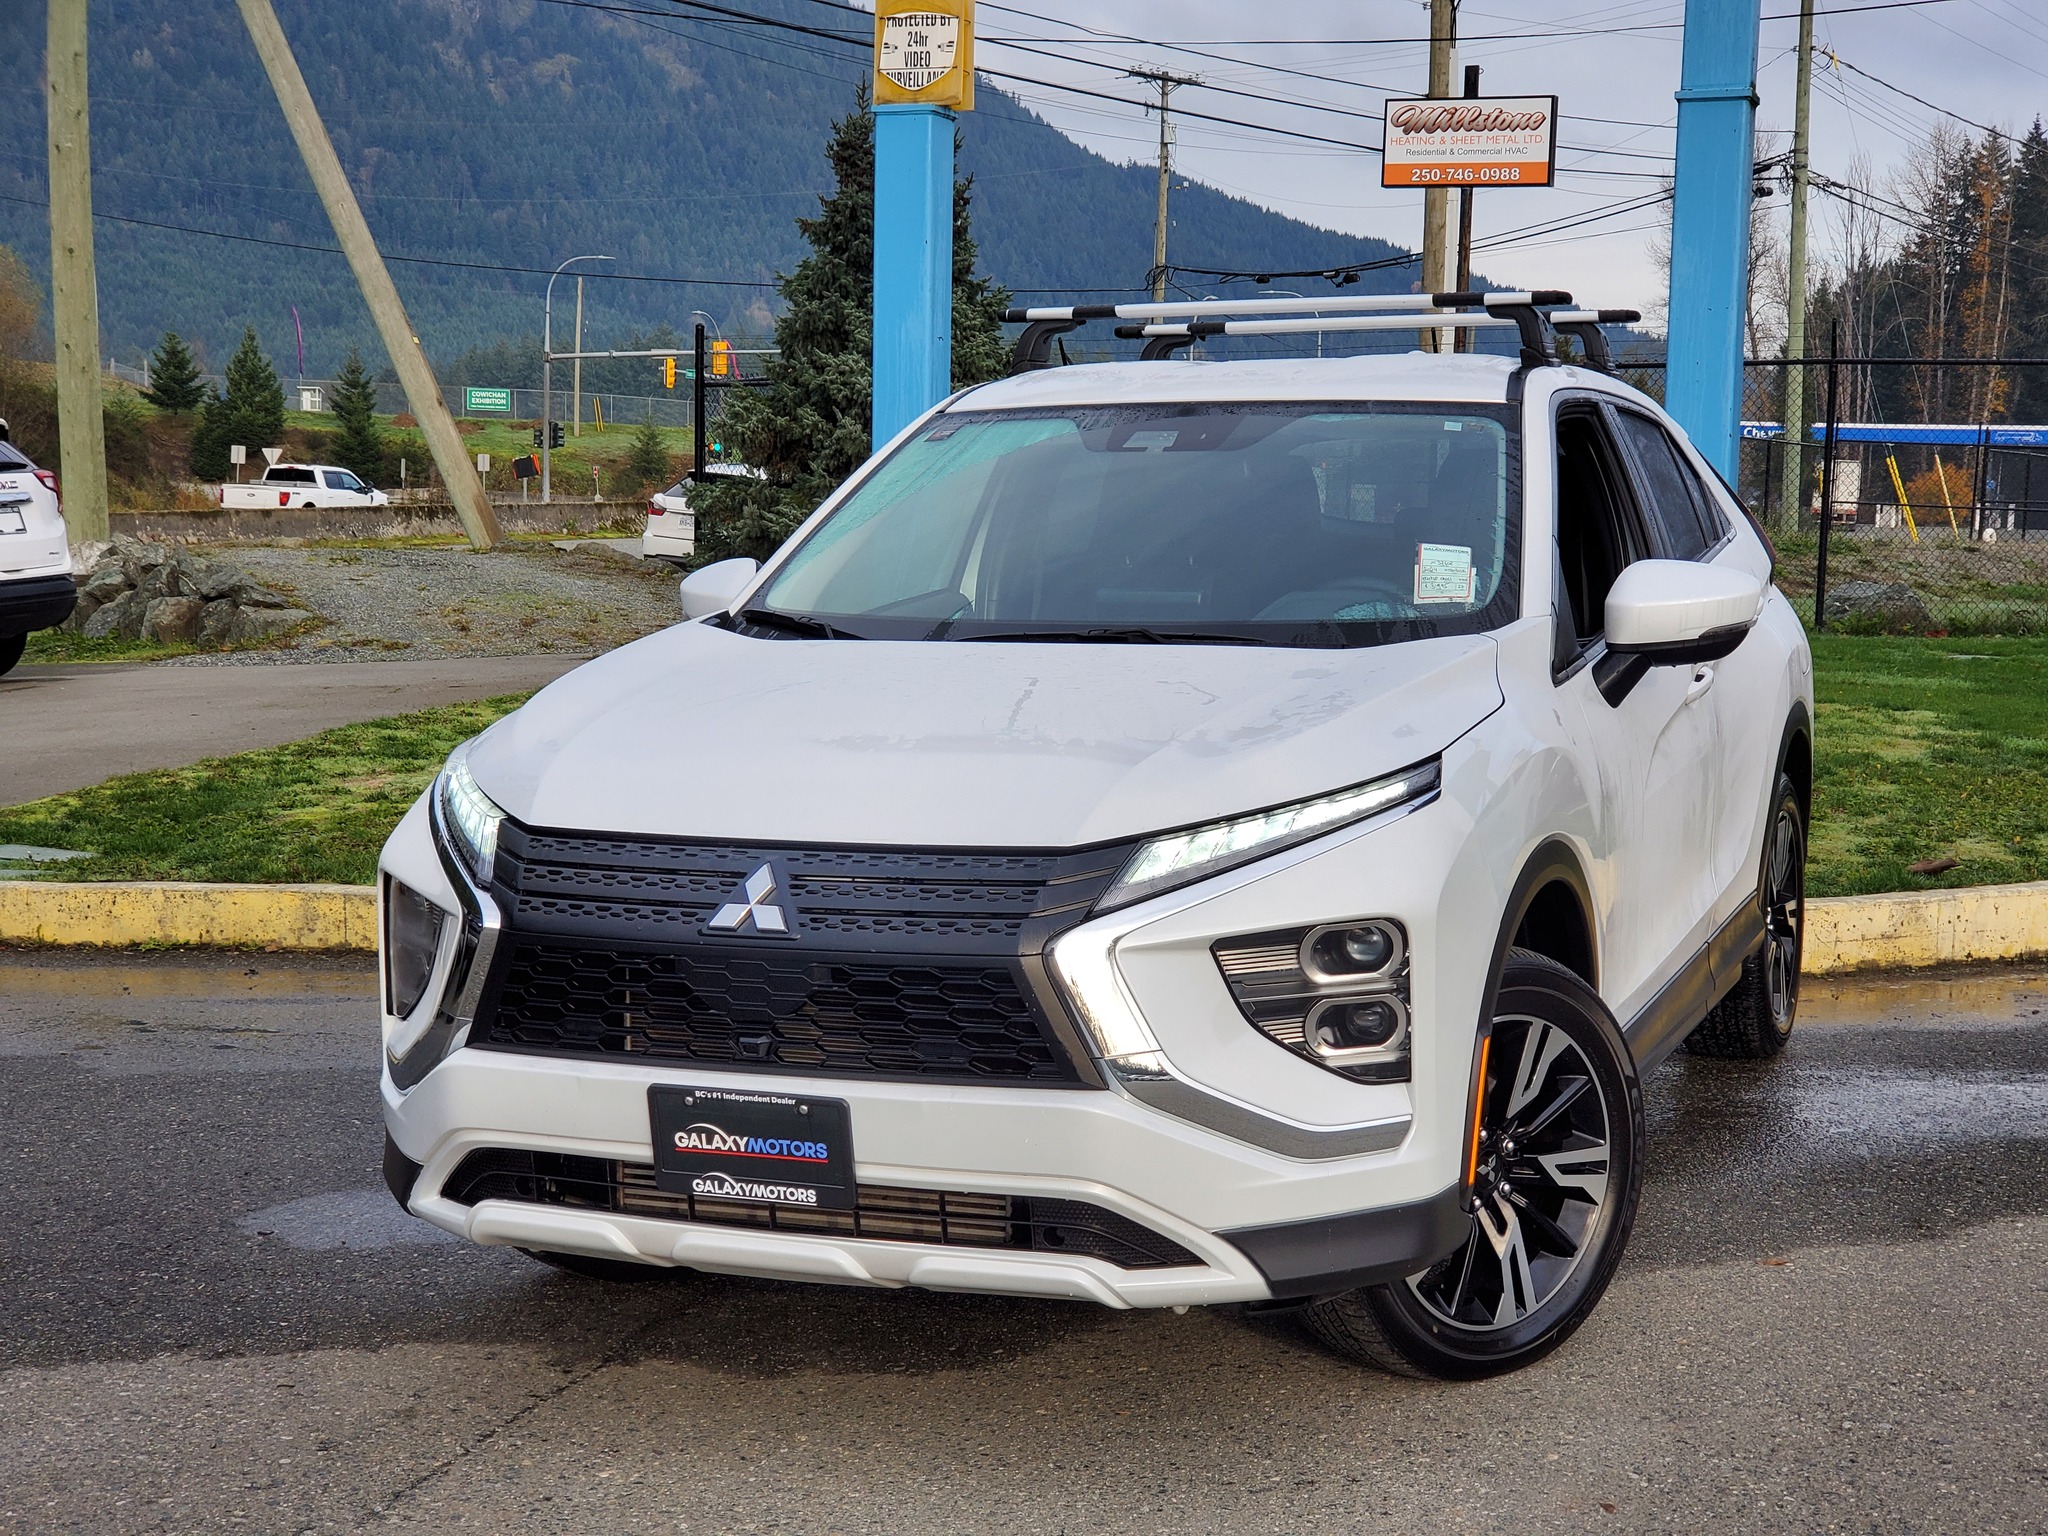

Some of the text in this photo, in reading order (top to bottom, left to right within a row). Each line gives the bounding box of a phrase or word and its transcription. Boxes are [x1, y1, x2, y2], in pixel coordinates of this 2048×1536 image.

[886, 14, 951, 28] PROTECTED BY
[907, 31, 929, 47] 24hr
[904, 51, 931, 67] VIDEO
[1390, 105, 1547, 135] Millstone
[1390, 134, 1545, 146] HEATING & SHEET METAL LTD.
[1405, 148, 1447, 156] Residential
[1457, 147, 1503, 155] Commercial
[1504, 147, 1528, 155] HVAC
[1411, 168, 1520, 181] 250-746-0988
[471, 397, 506, 405] EXHIBITION
[1743, 427, 1786, 438] Chev
[0, 481, 18, 490] MC
[694, 1090, 711, 1099] BC's
[723, 1092, 770, 1103] Independent
[771, 1096, 796, 1105] Dealer
[674, 1130, 828, 1159] GALAXYMOTORS
[692, 1178, 817, 1203] GALAXYMOTORS
